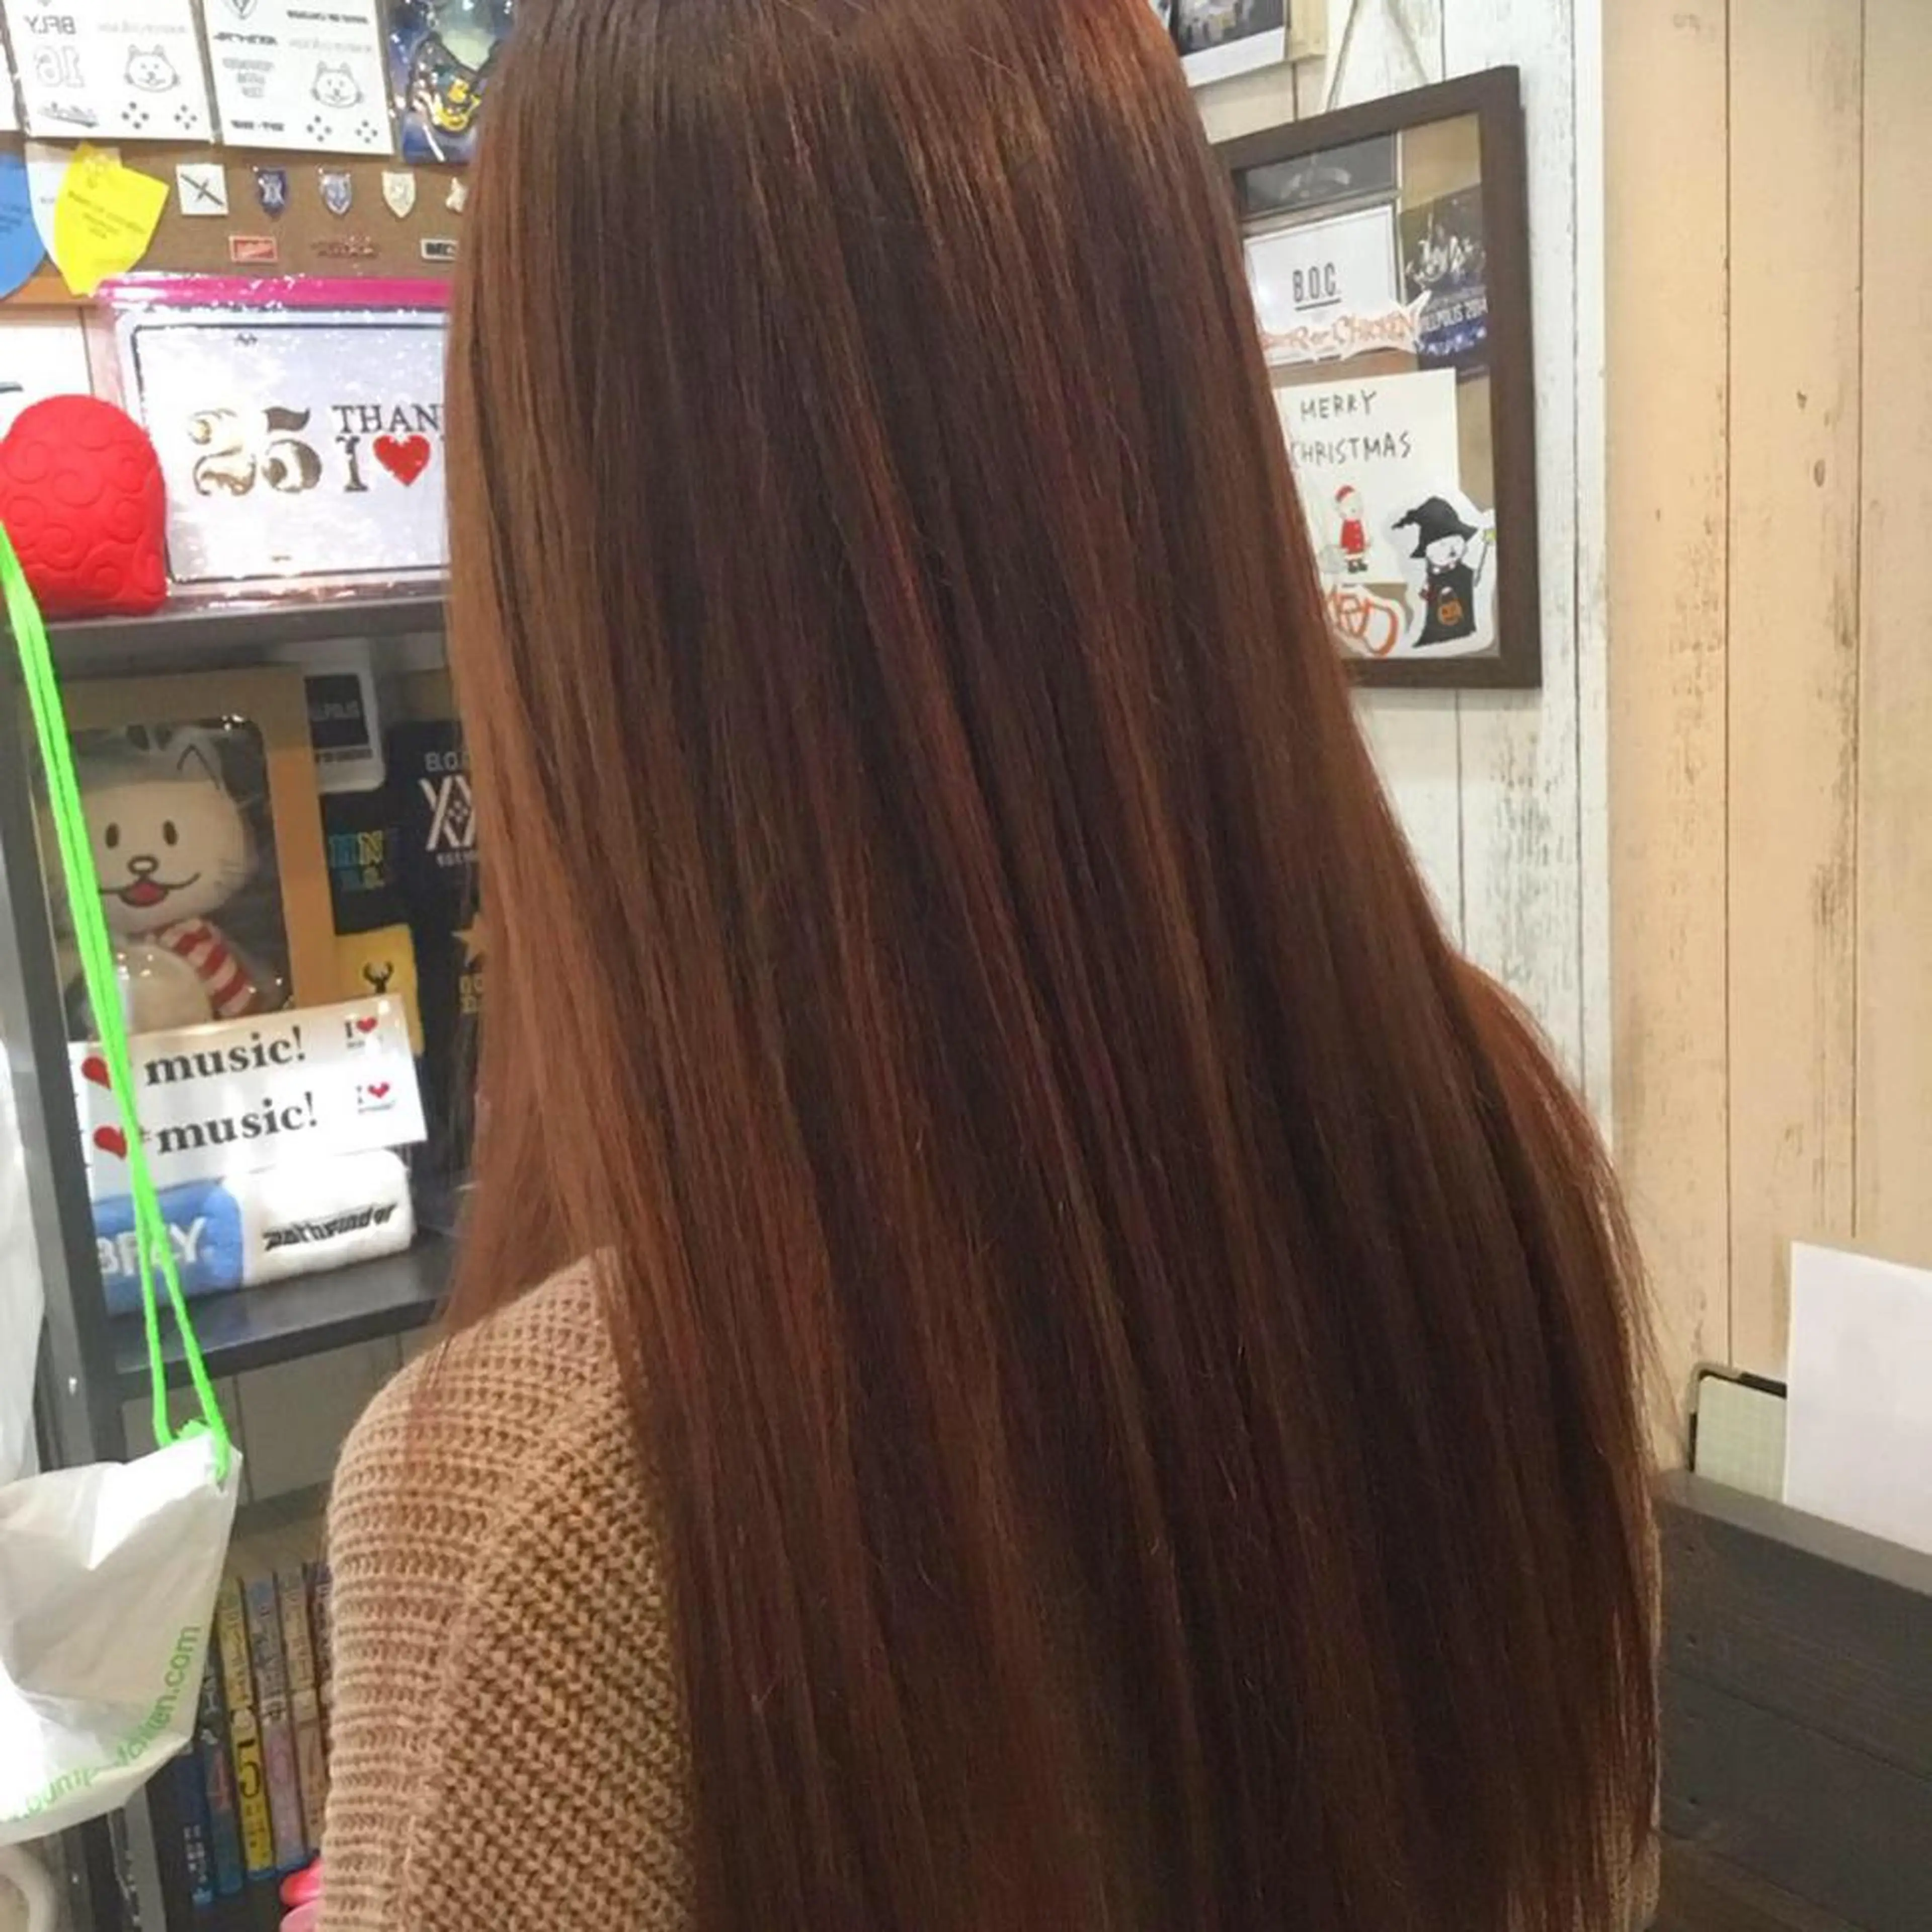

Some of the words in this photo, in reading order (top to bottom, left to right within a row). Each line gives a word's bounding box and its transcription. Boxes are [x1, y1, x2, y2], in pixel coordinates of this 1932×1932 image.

[332, 404, 443, 433] THAN
[1300, 389, 1377, 421] MERRY
[144, 1026, 305, 1086] music!
[156, 1091, 317, 1154] music!
